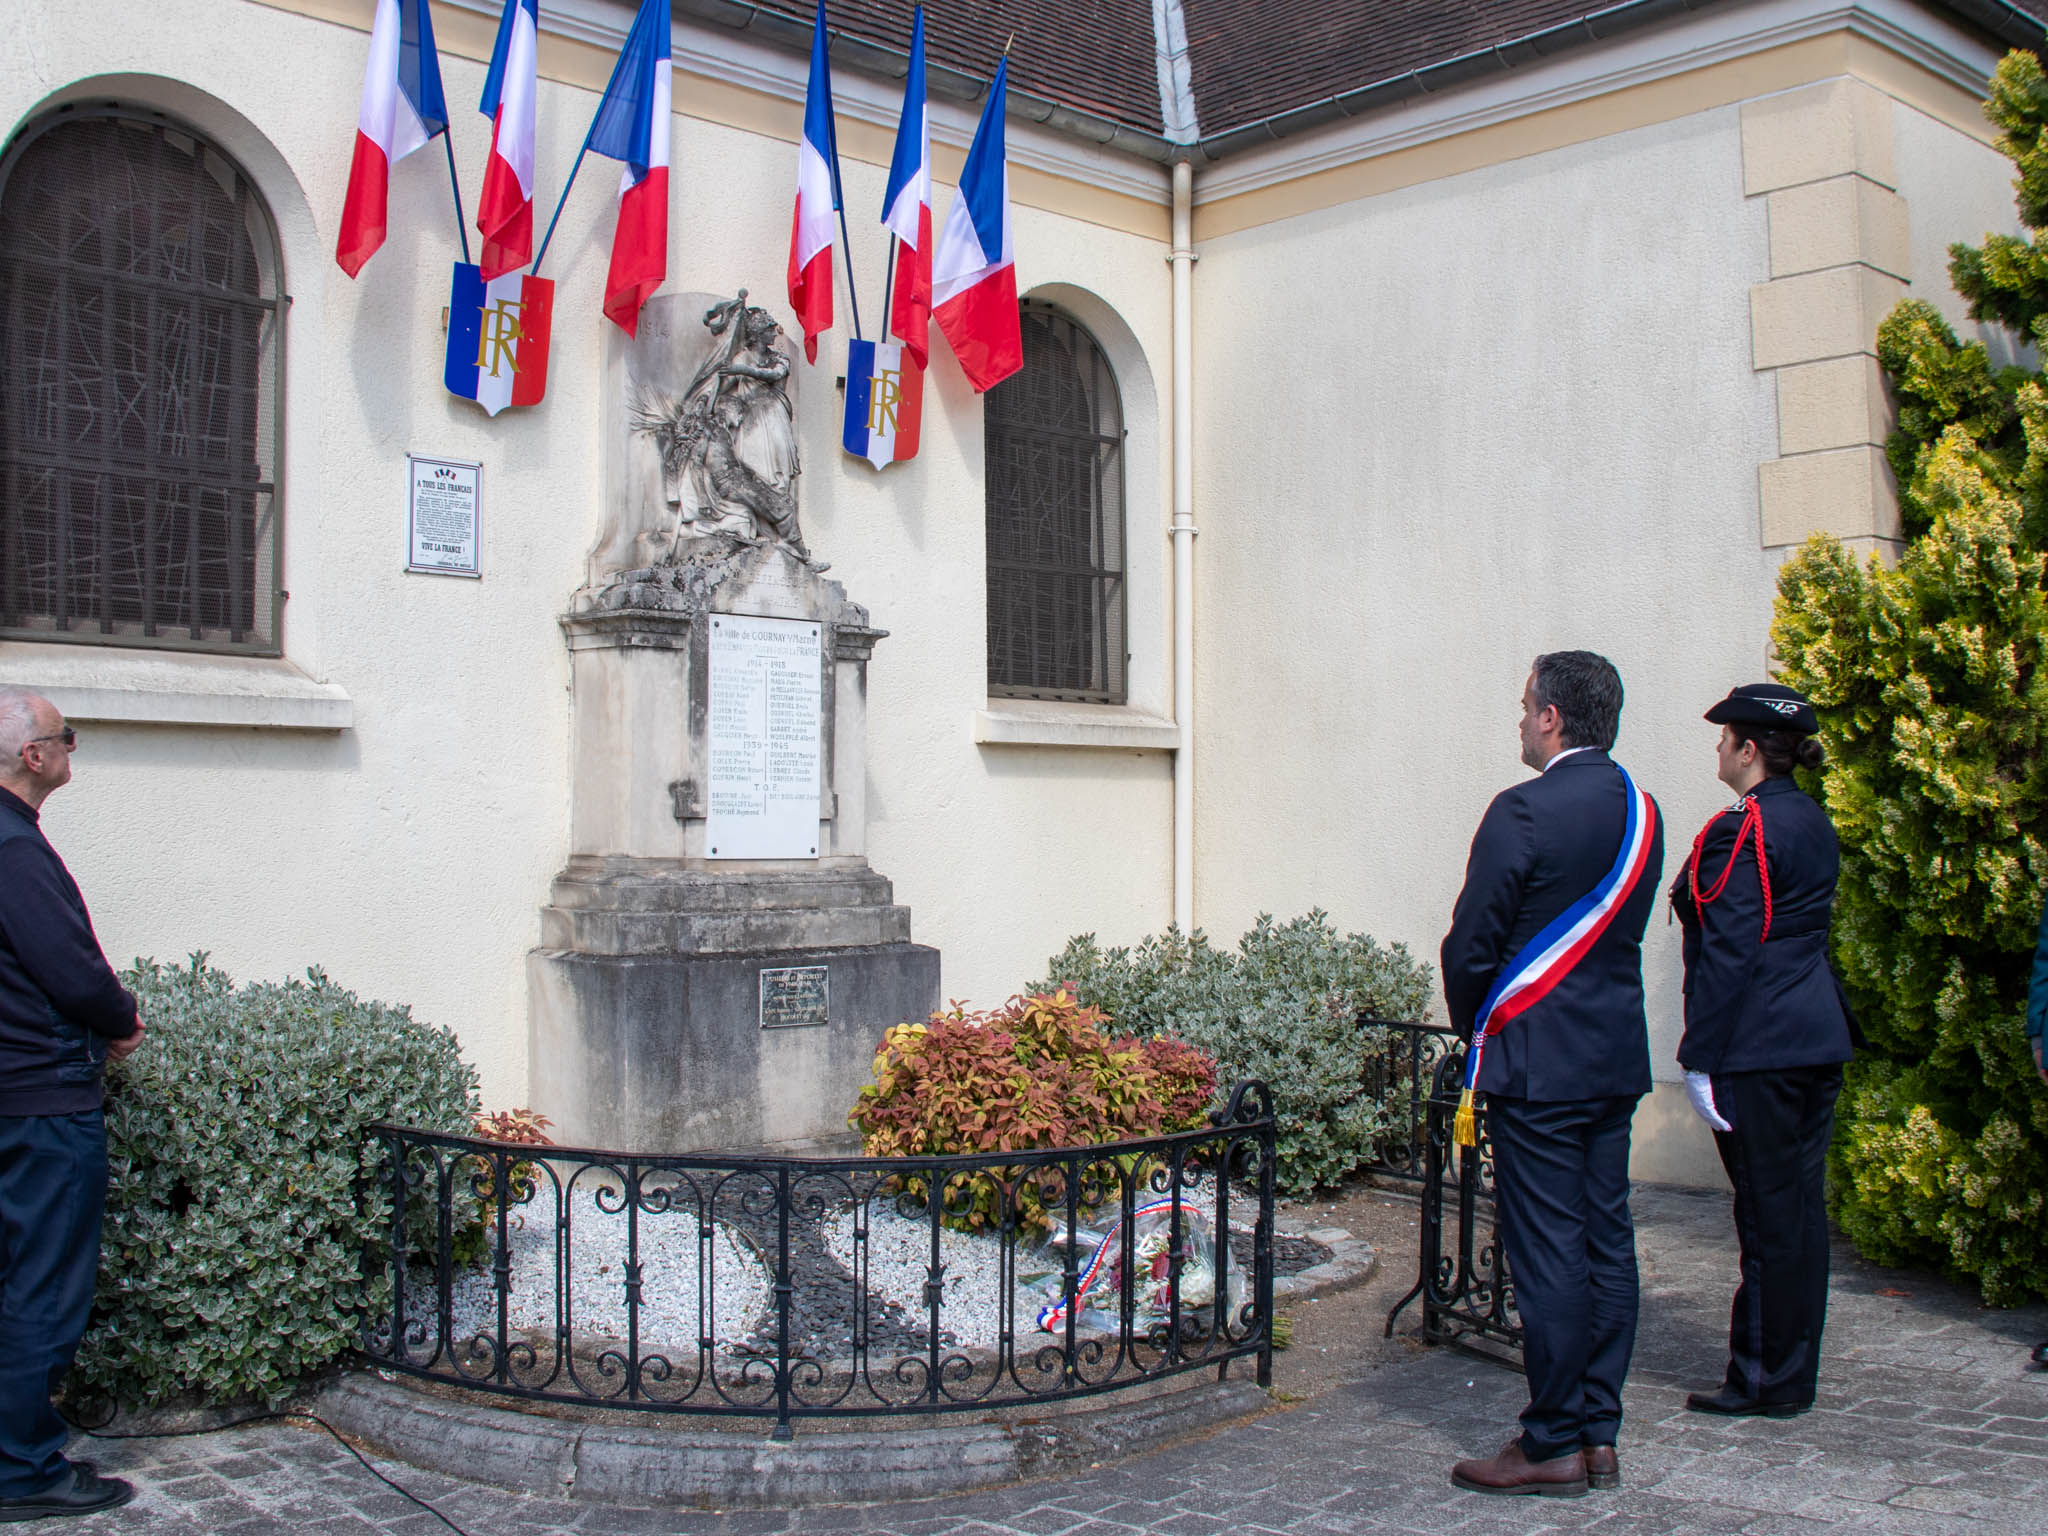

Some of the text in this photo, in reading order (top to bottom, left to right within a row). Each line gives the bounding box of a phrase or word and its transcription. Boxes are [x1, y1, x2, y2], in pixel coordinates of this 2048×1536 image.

[423, 480, 436, 490] TOUS
[437, 482, 447, 491] LES
[422, 542, 433, 551] VIVE
[434, 543, 441, 552] LA
[442, 544, 462, 554] FRANCE
